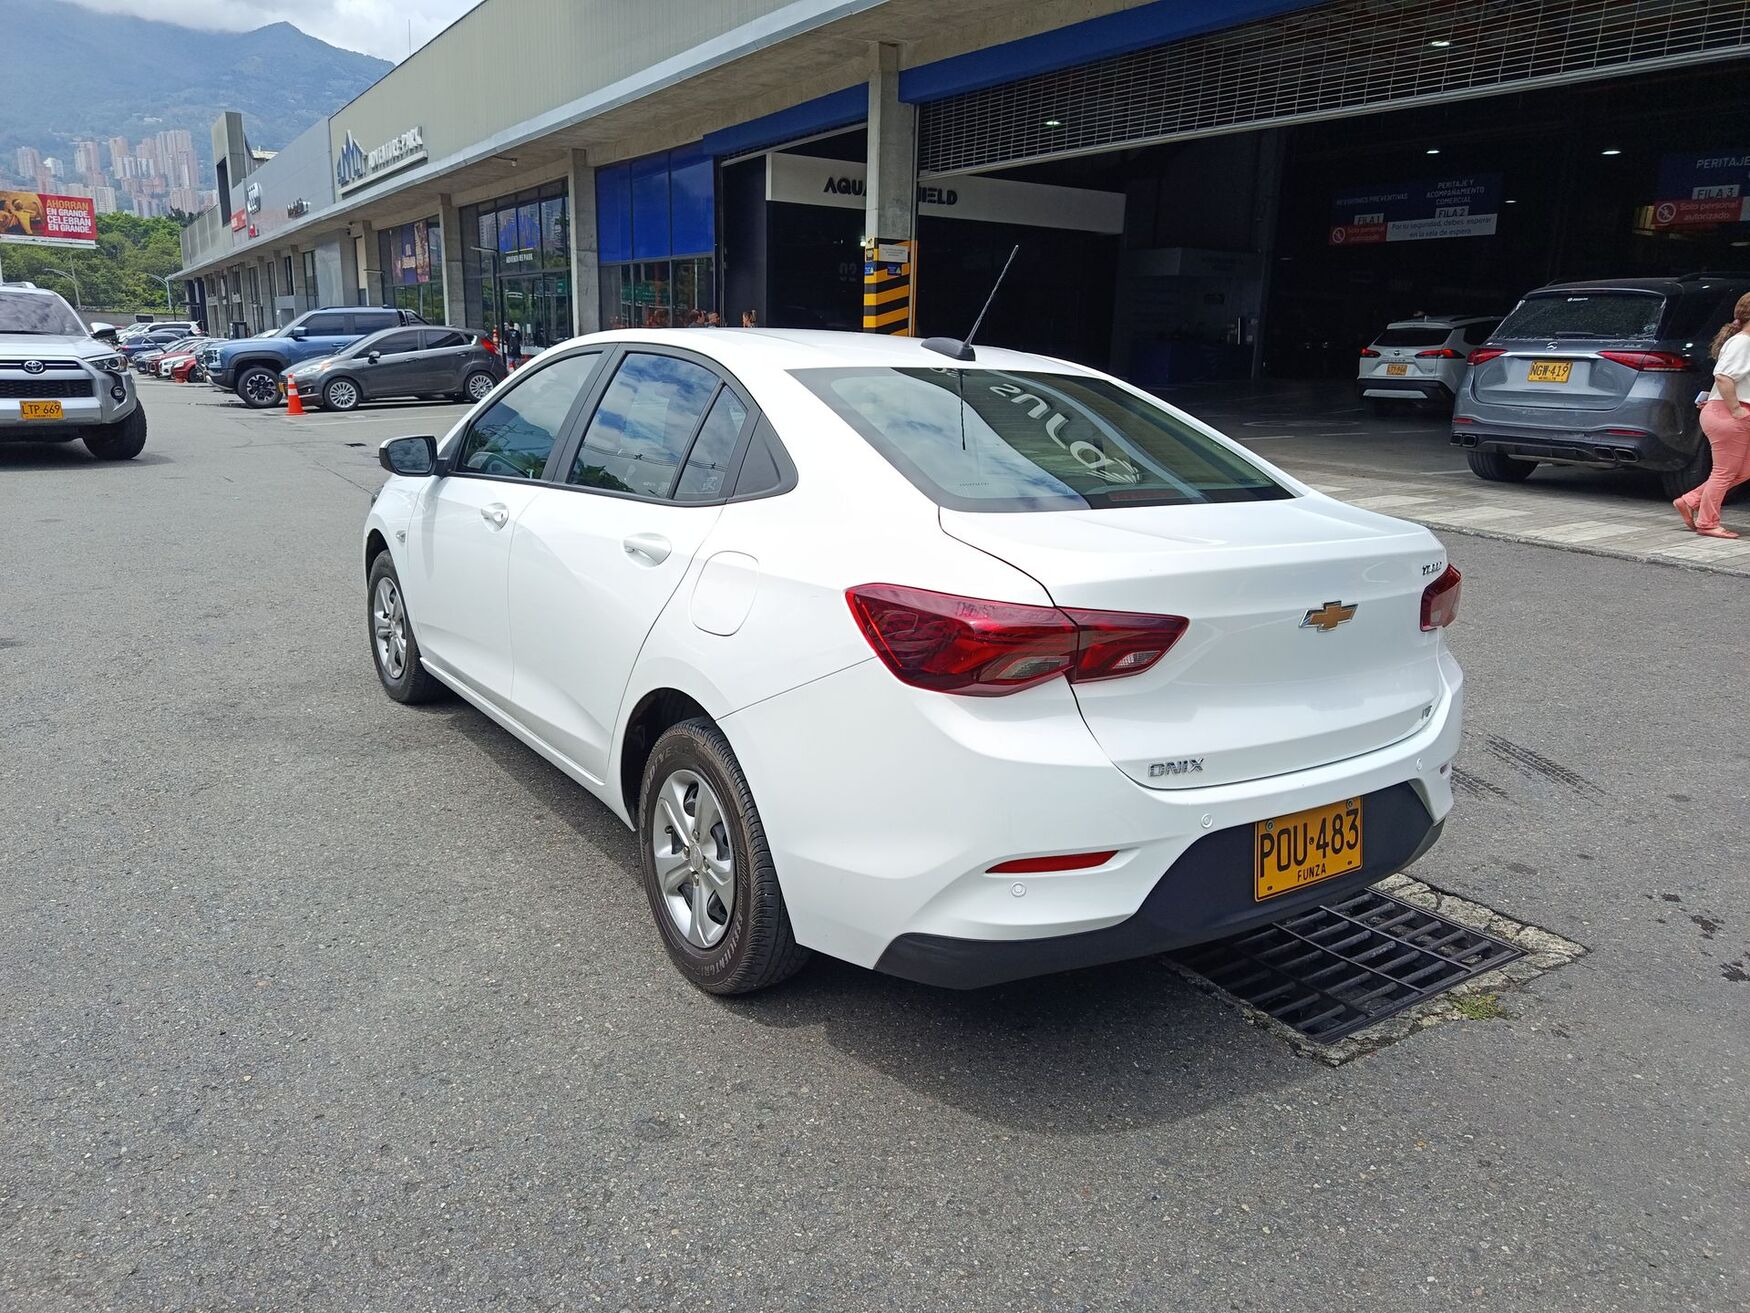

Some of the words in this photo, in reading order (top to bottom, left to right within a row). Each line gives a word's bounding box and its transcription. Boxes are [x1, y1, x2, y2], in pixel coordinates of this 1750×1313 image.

[1696, 155, 1750, 169] PERITAJE
[823, 177, 866, 197] AQU
[1697, 189, 1724, 199] FILA
[1726, 187, 1733, 198] 3
[46, 199, 89, 210] AHORRAN
[46, 207, 57, 216] EN
[1438, 208, 1458, 218] FILA
[47, 215, 92, 227] CELEBRAN
[1357, 215, 1375, 224] FILA
[48, 223, 59, 231] EN
[1148, 758, 1204, 778] ONIX
[1297, 862, 1327, 882] FUNZA
